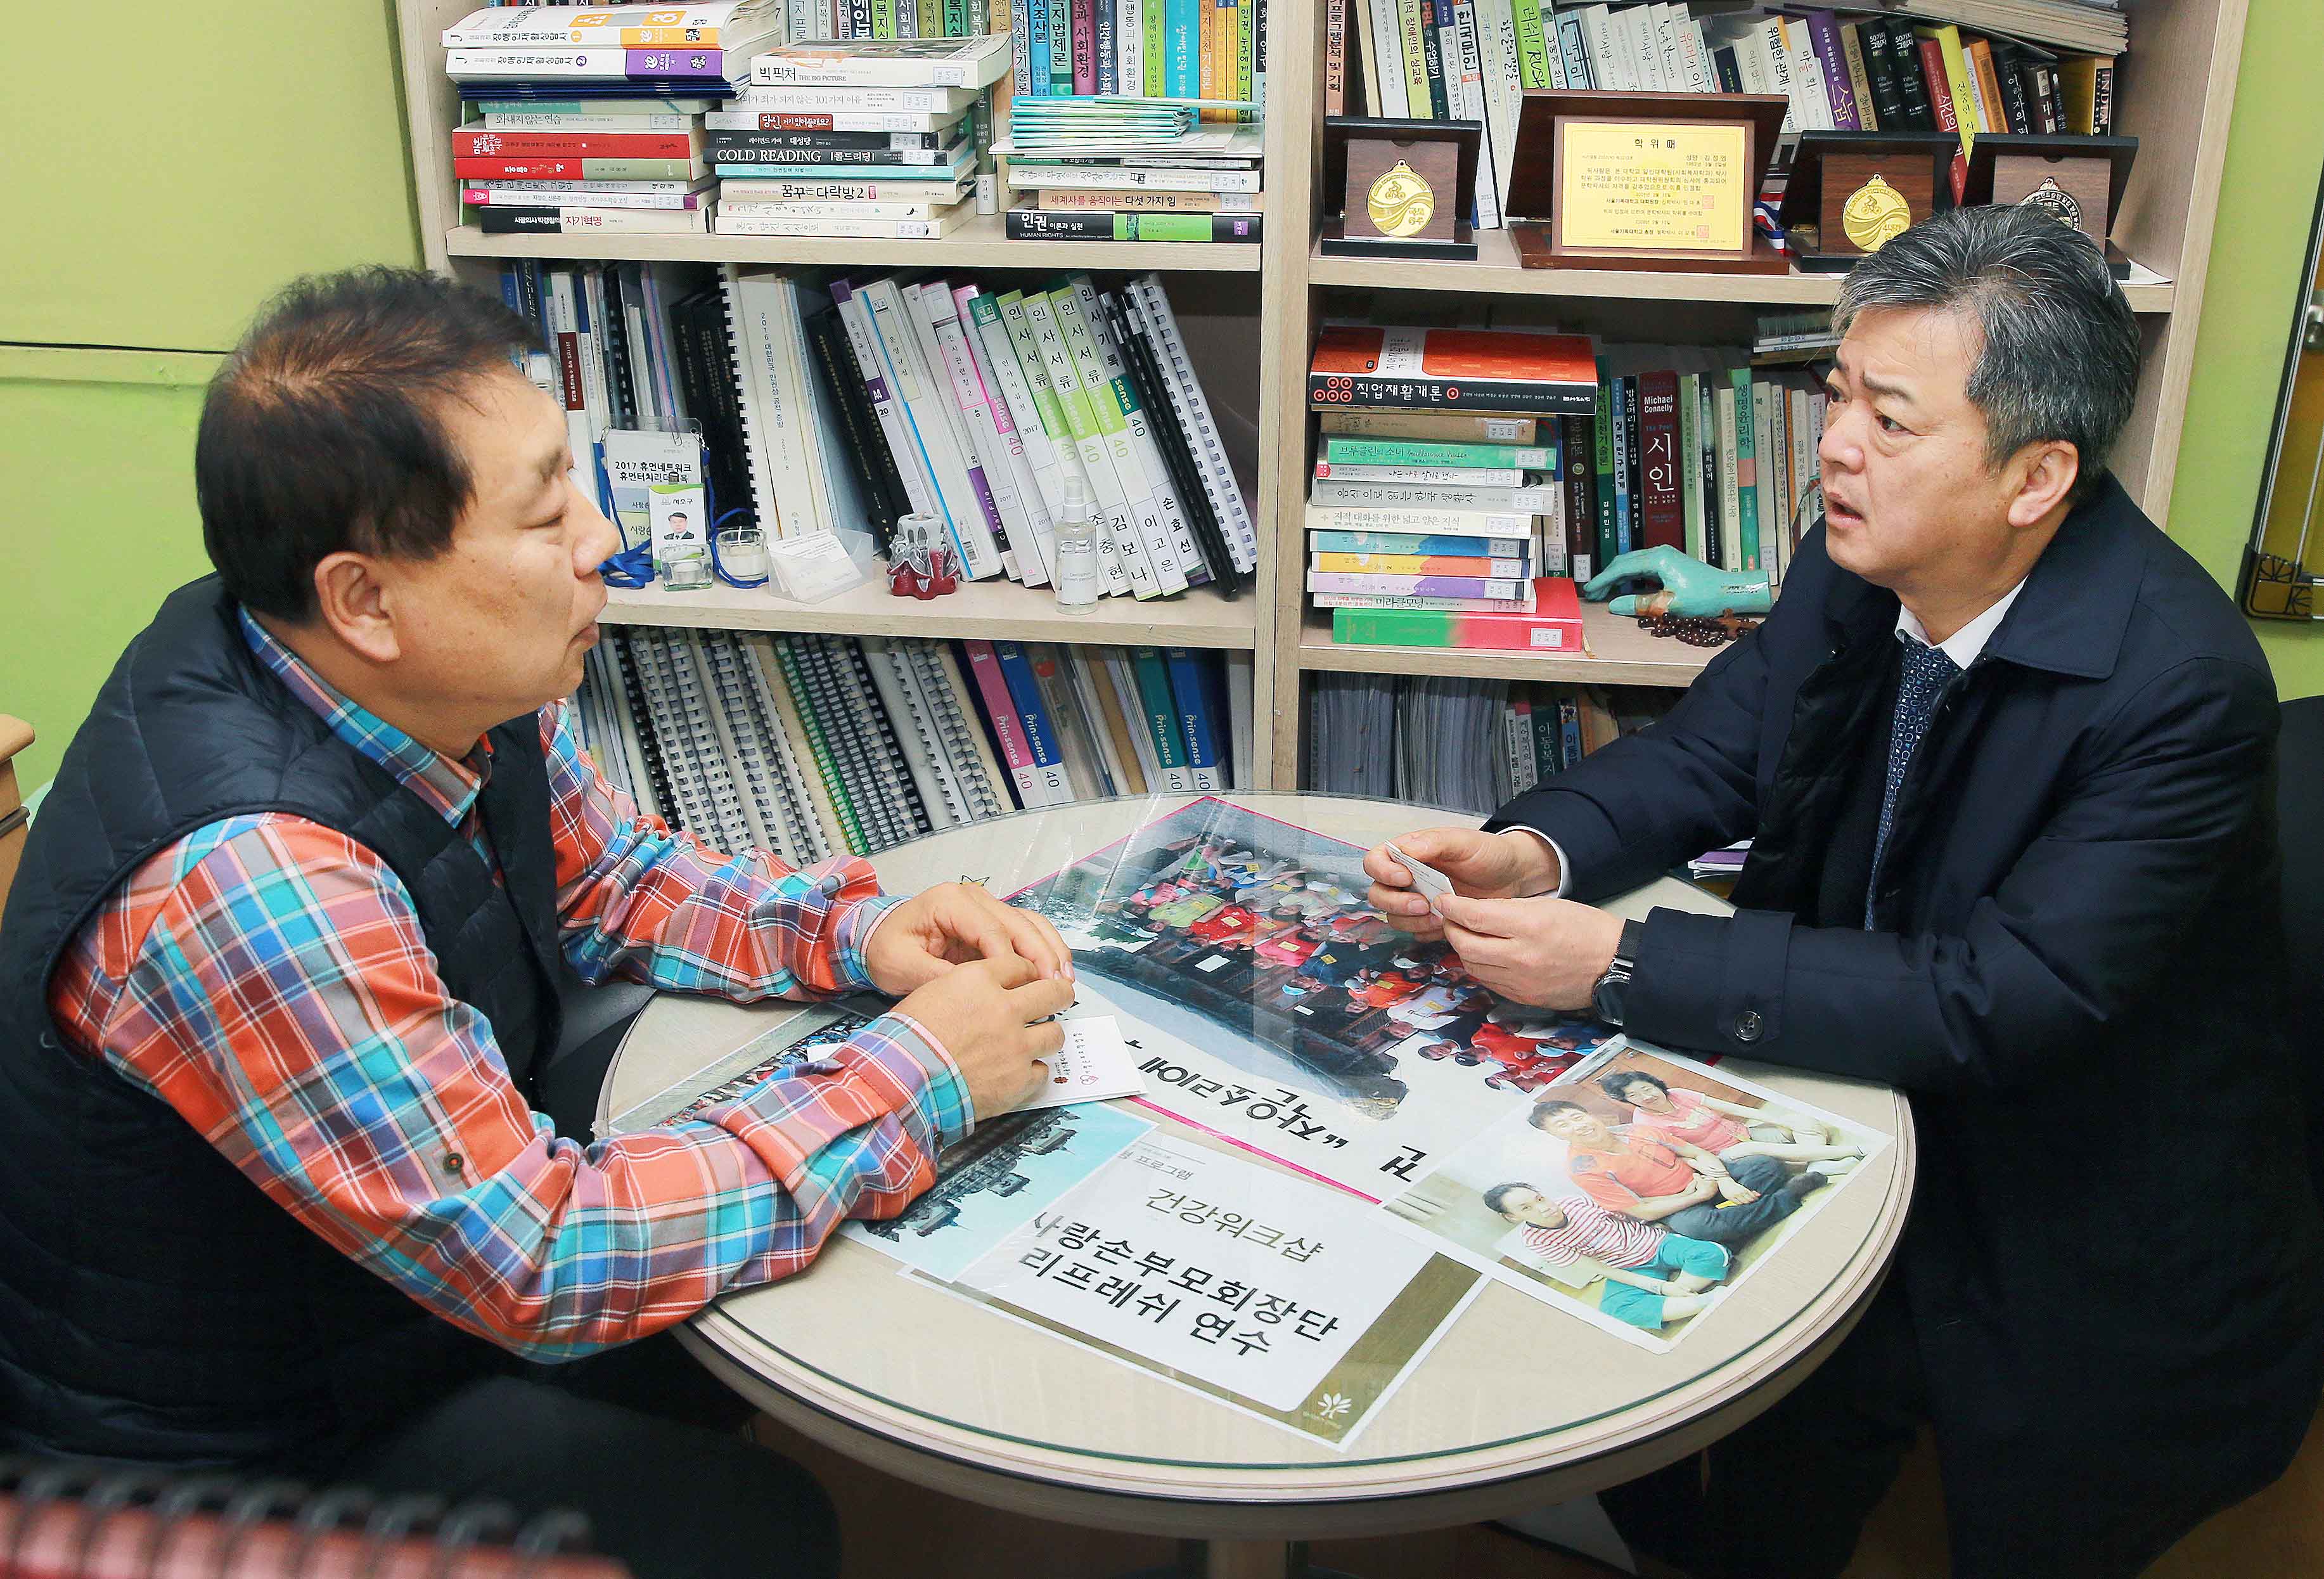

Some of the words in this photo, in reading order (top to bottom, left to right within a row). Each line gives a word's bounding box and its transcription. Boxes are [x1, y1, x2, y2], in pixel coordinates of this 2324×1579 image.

[1200, 0, 1212, 90] 복지실천기술론
[1767, 27, 1785, 61] 위험한
[760, 67, 771, 81] 빅
[1775, 61, 1790, 86] 관계
[717, 149, 755, 161] COLD
[760, 150, 822, 162] READING
[781, 184, 815, 200] 꿈꾸는
[1051, 195, 1086, 207] 세계사를
[1088, 195, 1123, 207] 움직이는
[1125, 196, 1143, 207] 다섯
[1146, 196, 1164, 207] 가지
[1166, 196, 1176, 207] 힘
[566, 216, 603, 226] 자기혁명
[1019, 212, 1048, 231] 인권
[1081, 286, 1120, 368] 인사기록
[1008, 304, 1048, 387] 인사서류
[1032, 307, 1072, 390] 인사서류
[1061, 300, 1101, 384] 인사서류
[1356, 382, 1443, 403] 직업재활개론
[1644, 395, 1674, 404] Michael
[878, 408, 889, 416] 20
[1644, 404, 1674, 413] Connelly
[1022, 424, 1040, 436] 2017
[1131, 417, 1146, 437] 40
[1008, 437, 1024, 456] 40
[1386, 447, 1405, 458] 소녀
[615, 461, 637, 470] 2017
[1647, 433, 1676, 493] 시인
[1162, 496, 1193, 554] 손효선
[1333, 511, 1352, 522] 지적
[1353, 512, 1381, 524] 대화를
[1382, 513, 1401, 525] 위한
[1442, 516, 1460, 527] 지식
[1089, 512, 1126, 581] 조충현
[1110, 513, 1149, 583] 김보나
[1143, 514, 1174, 573] 이고은
[1375, 596, 1424, 609] 미라클모닝
[1018, 772, 1033, 790] 40
[1045, 770, 1060, 787] 40
[1169, 772, 1183, 790] 40
[1197, 771, 1212, 790] 40
[1134, 1153, 1195, 1182] 프로그램
[1146, 1186, 1326, 1265] 건강워크샵
[1033, 1211, 1340, 1343] 사랑손부모회장단
[1019, 1246, 1182, 1324] 리프레쉬
[1189, 1310, 1274, 1357] 연수
